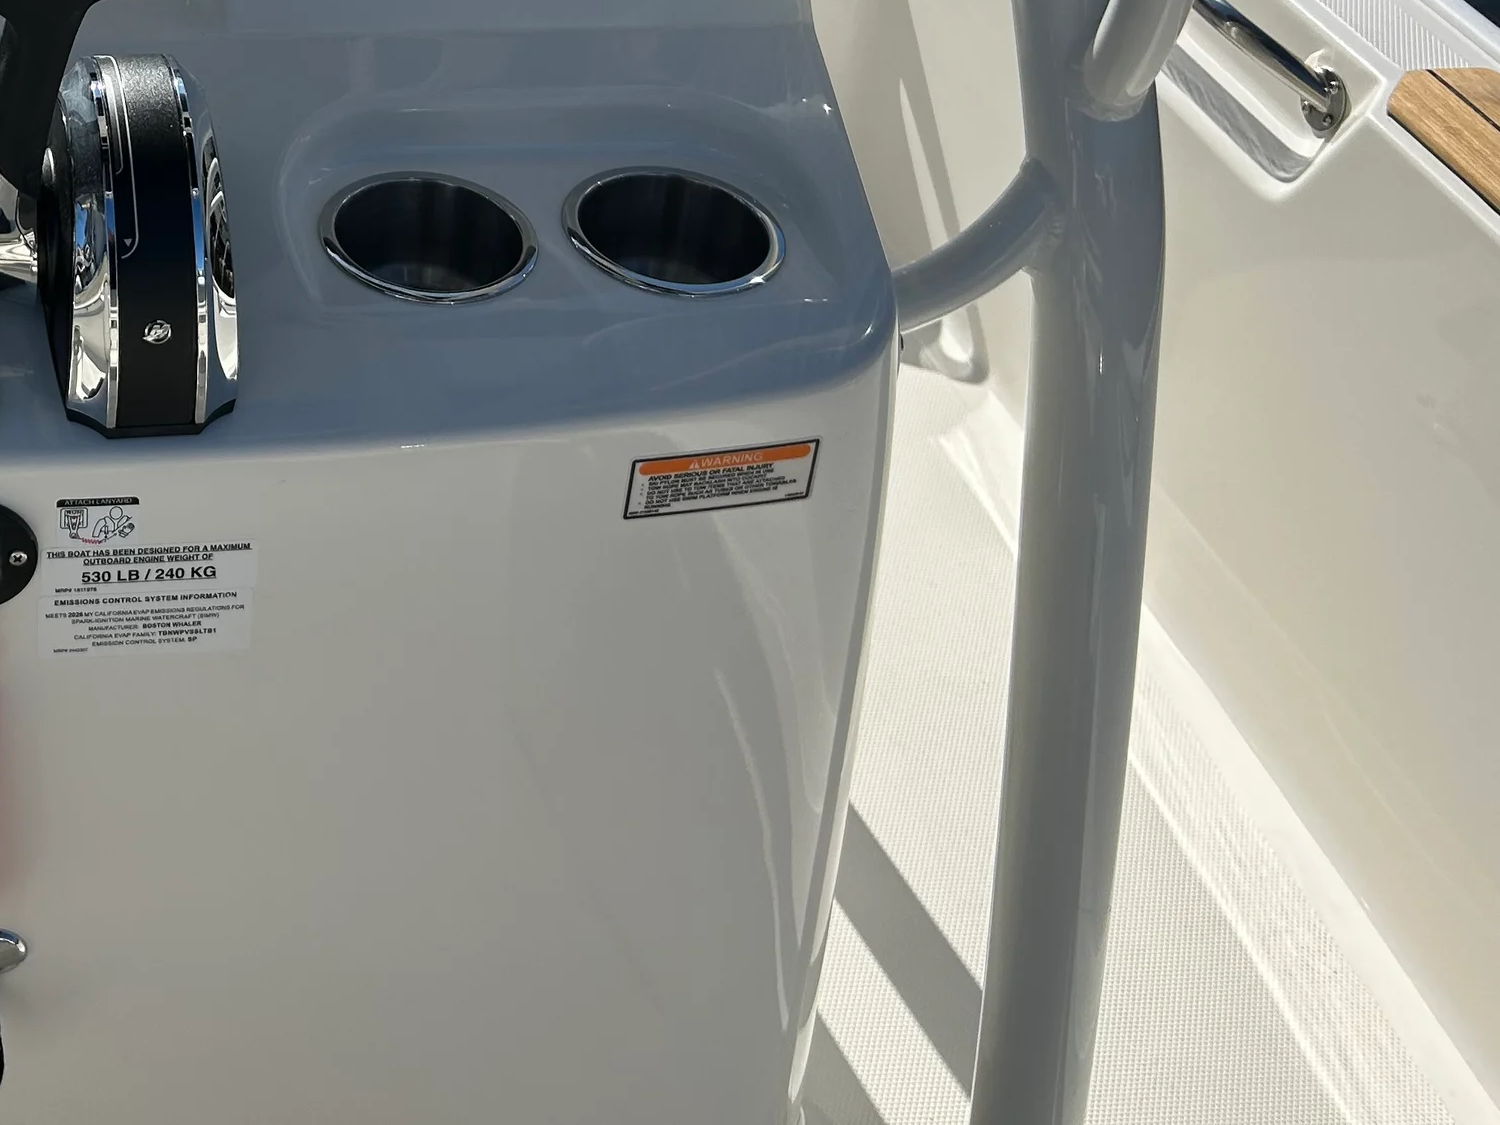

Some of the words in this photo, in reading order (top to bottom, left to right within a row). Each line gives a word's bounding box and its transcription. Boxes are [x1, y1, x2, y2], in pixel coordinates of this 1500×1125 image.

[700, 453, 763, 468] WARNING
[47, 551, 66, 559] THIS
[68, 550, 91, 558] BOAT
[93, 549, 110, 557] HAS
[113, 548, 135, 556] BEEN
[138, 546, 180, 555] DESIGNED
[210, 543, 251, 551] MAXIMUM
[83, 557, 131, 566] OUTBOARD
[133, 555, 164, 563] ENGINE
[167, 554, 199, 562] WEIGHT
[82, 570, 111, 583] 530
[117, 570, 140, 581] LB
[144, 569, 151, 580] /
[155, 567, 185, 579] 240
[191, 566, 217, 578] KG
[54, 598, 100, 606] EMISSIONS
[103, 596, 142, 604] CONTROL
[145, 594, 178, 602] SYSTEM
[180, 591, 237, 601] INFORMATION
